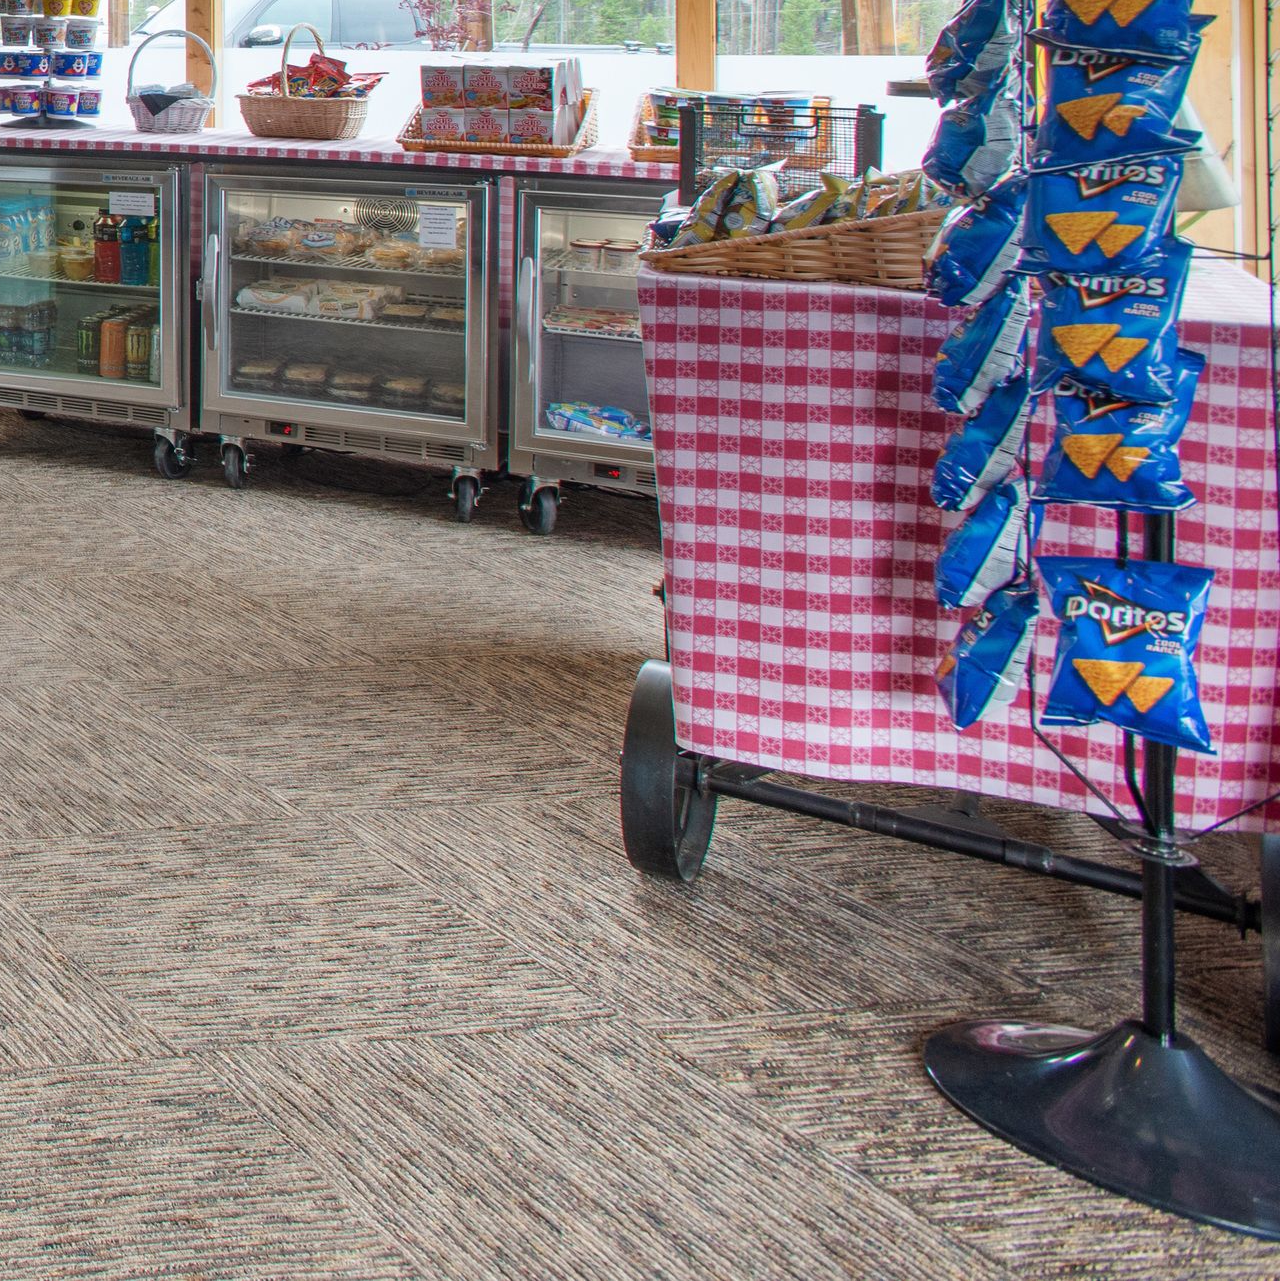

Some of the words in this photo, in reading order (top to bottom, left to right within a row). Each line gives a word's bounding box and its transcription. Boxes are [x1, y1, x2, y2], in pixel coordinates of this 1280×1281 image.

[1132, 190, 1158, 199] COOL
[1122, 195, 1158, 206] RANCH
[1133, 303, 1160, 311] COOL
[1123, 308, 1160, 317] RANCH
[1066, 596, 1186, 632] Doritos
